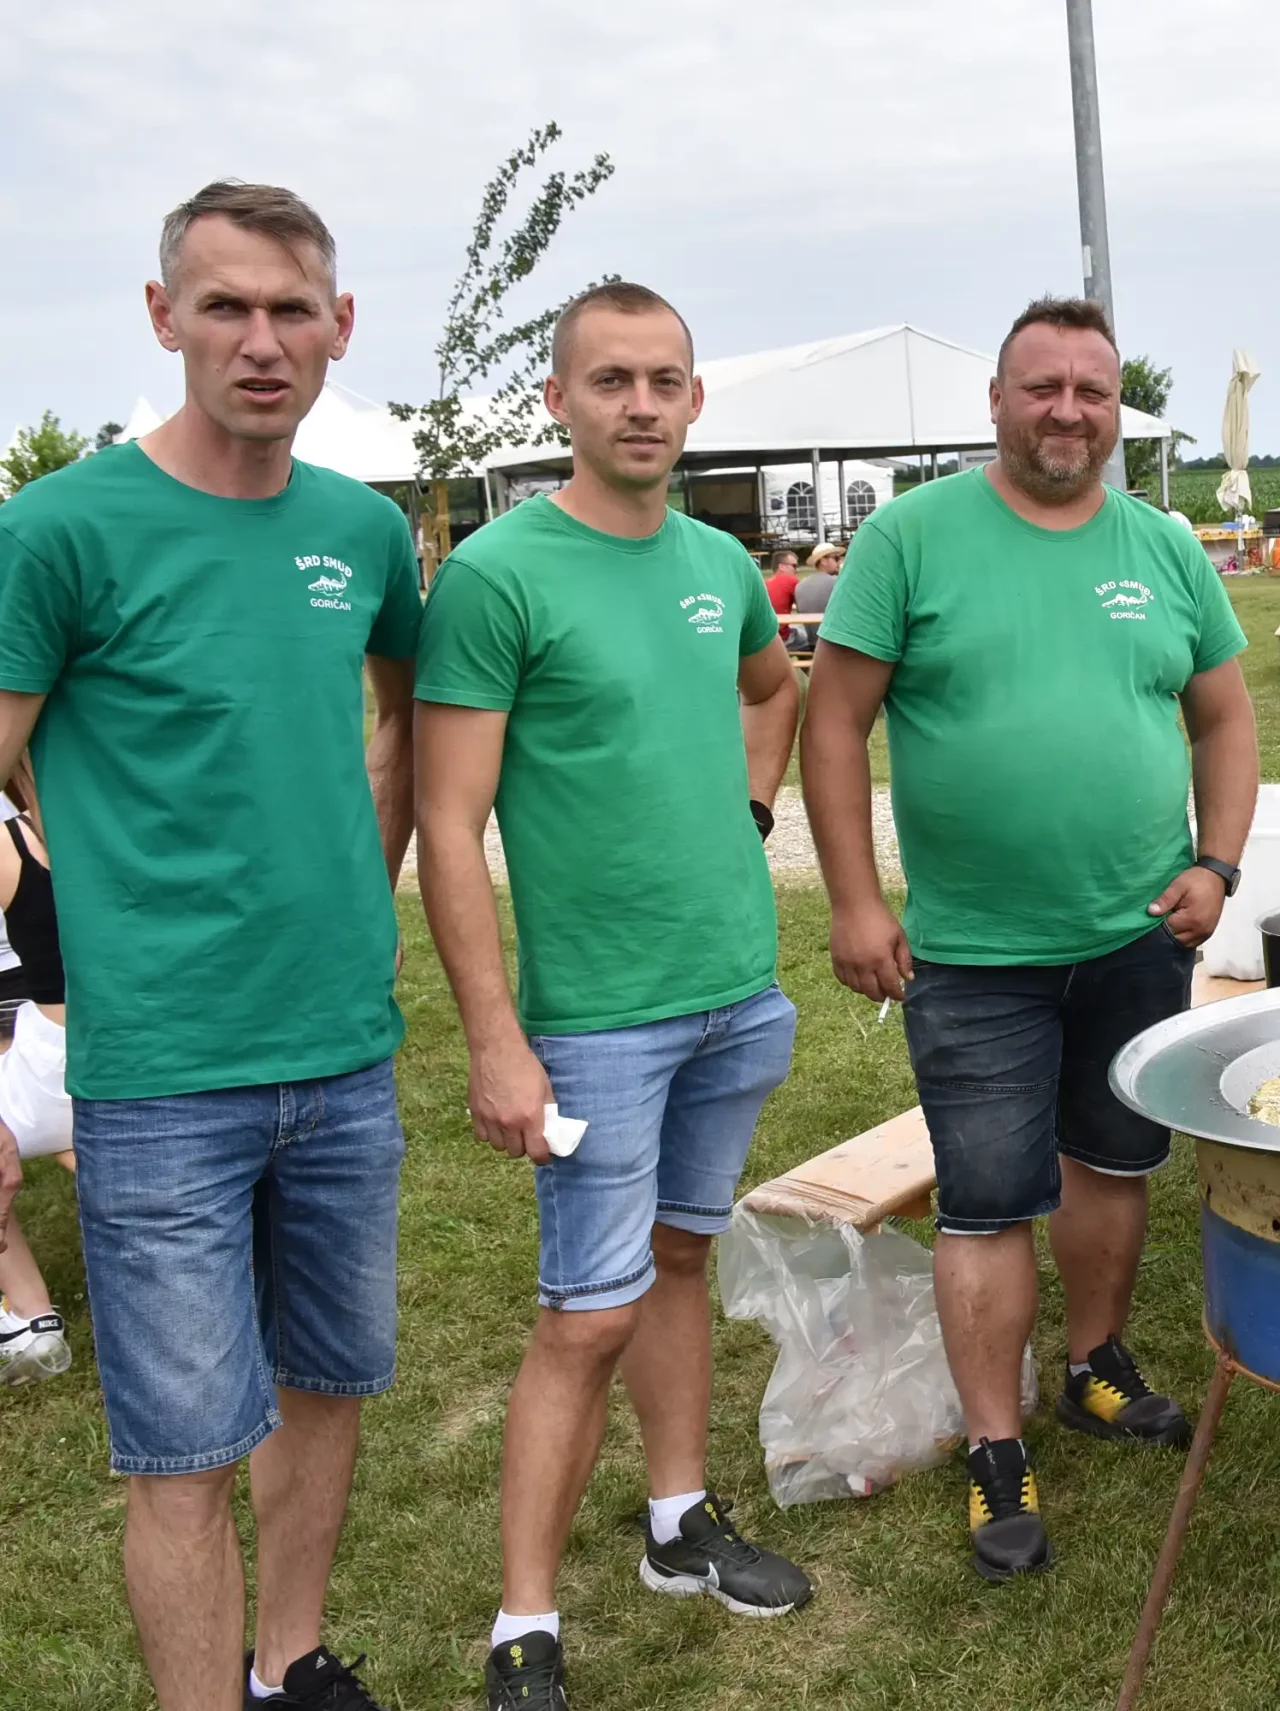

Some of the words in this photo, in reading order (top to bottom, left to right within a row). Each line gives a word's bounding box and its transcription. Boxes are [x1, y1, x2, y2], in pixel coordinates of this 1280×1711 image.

[294, 554, 321, 570] ŠRD
[1094, 581, 1117, 596] ŠRD
[310, 597, 352, 611] GORIČAN
[38, 1318, 60, 1329] NIKE
